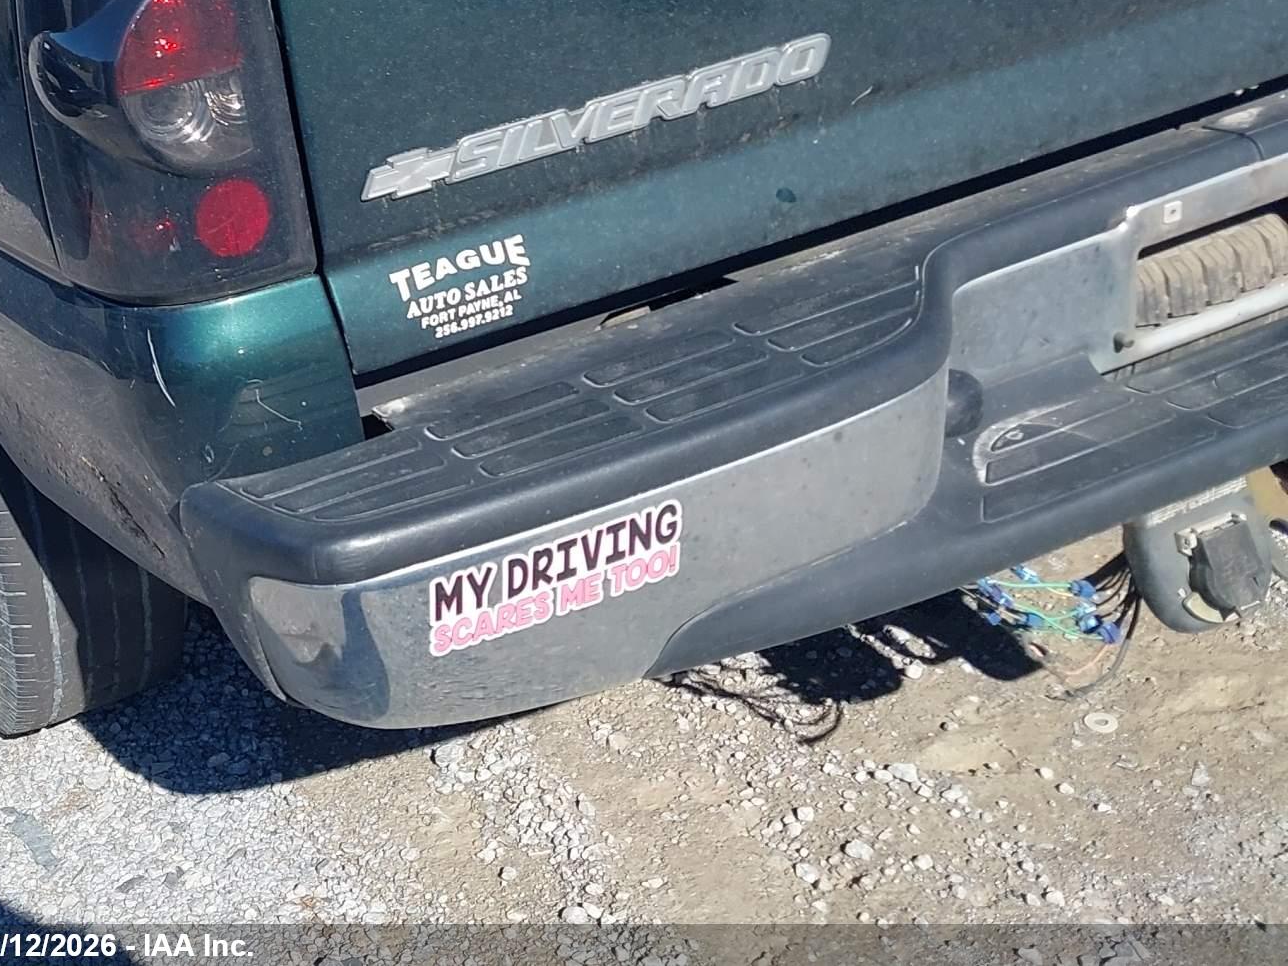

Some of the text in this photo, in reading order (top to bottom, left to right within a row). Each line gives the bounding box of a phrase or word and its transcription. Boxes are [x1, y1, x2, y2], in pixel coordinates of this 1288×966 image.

[446, 33, 830, 183] SILVERADO
[389, 234, 531, 302] TEAGUE
[407, 266, 528, 319] AUTO SALES
[421, 308, 456, 329] FORT
[503, 289, 522, 303] AL
[435, 305, 514, 339] 256.997.9212
[435, 504, 677, 622] MY DRIVING
[433, 545, 677, 653] SCARES ME TOO!
